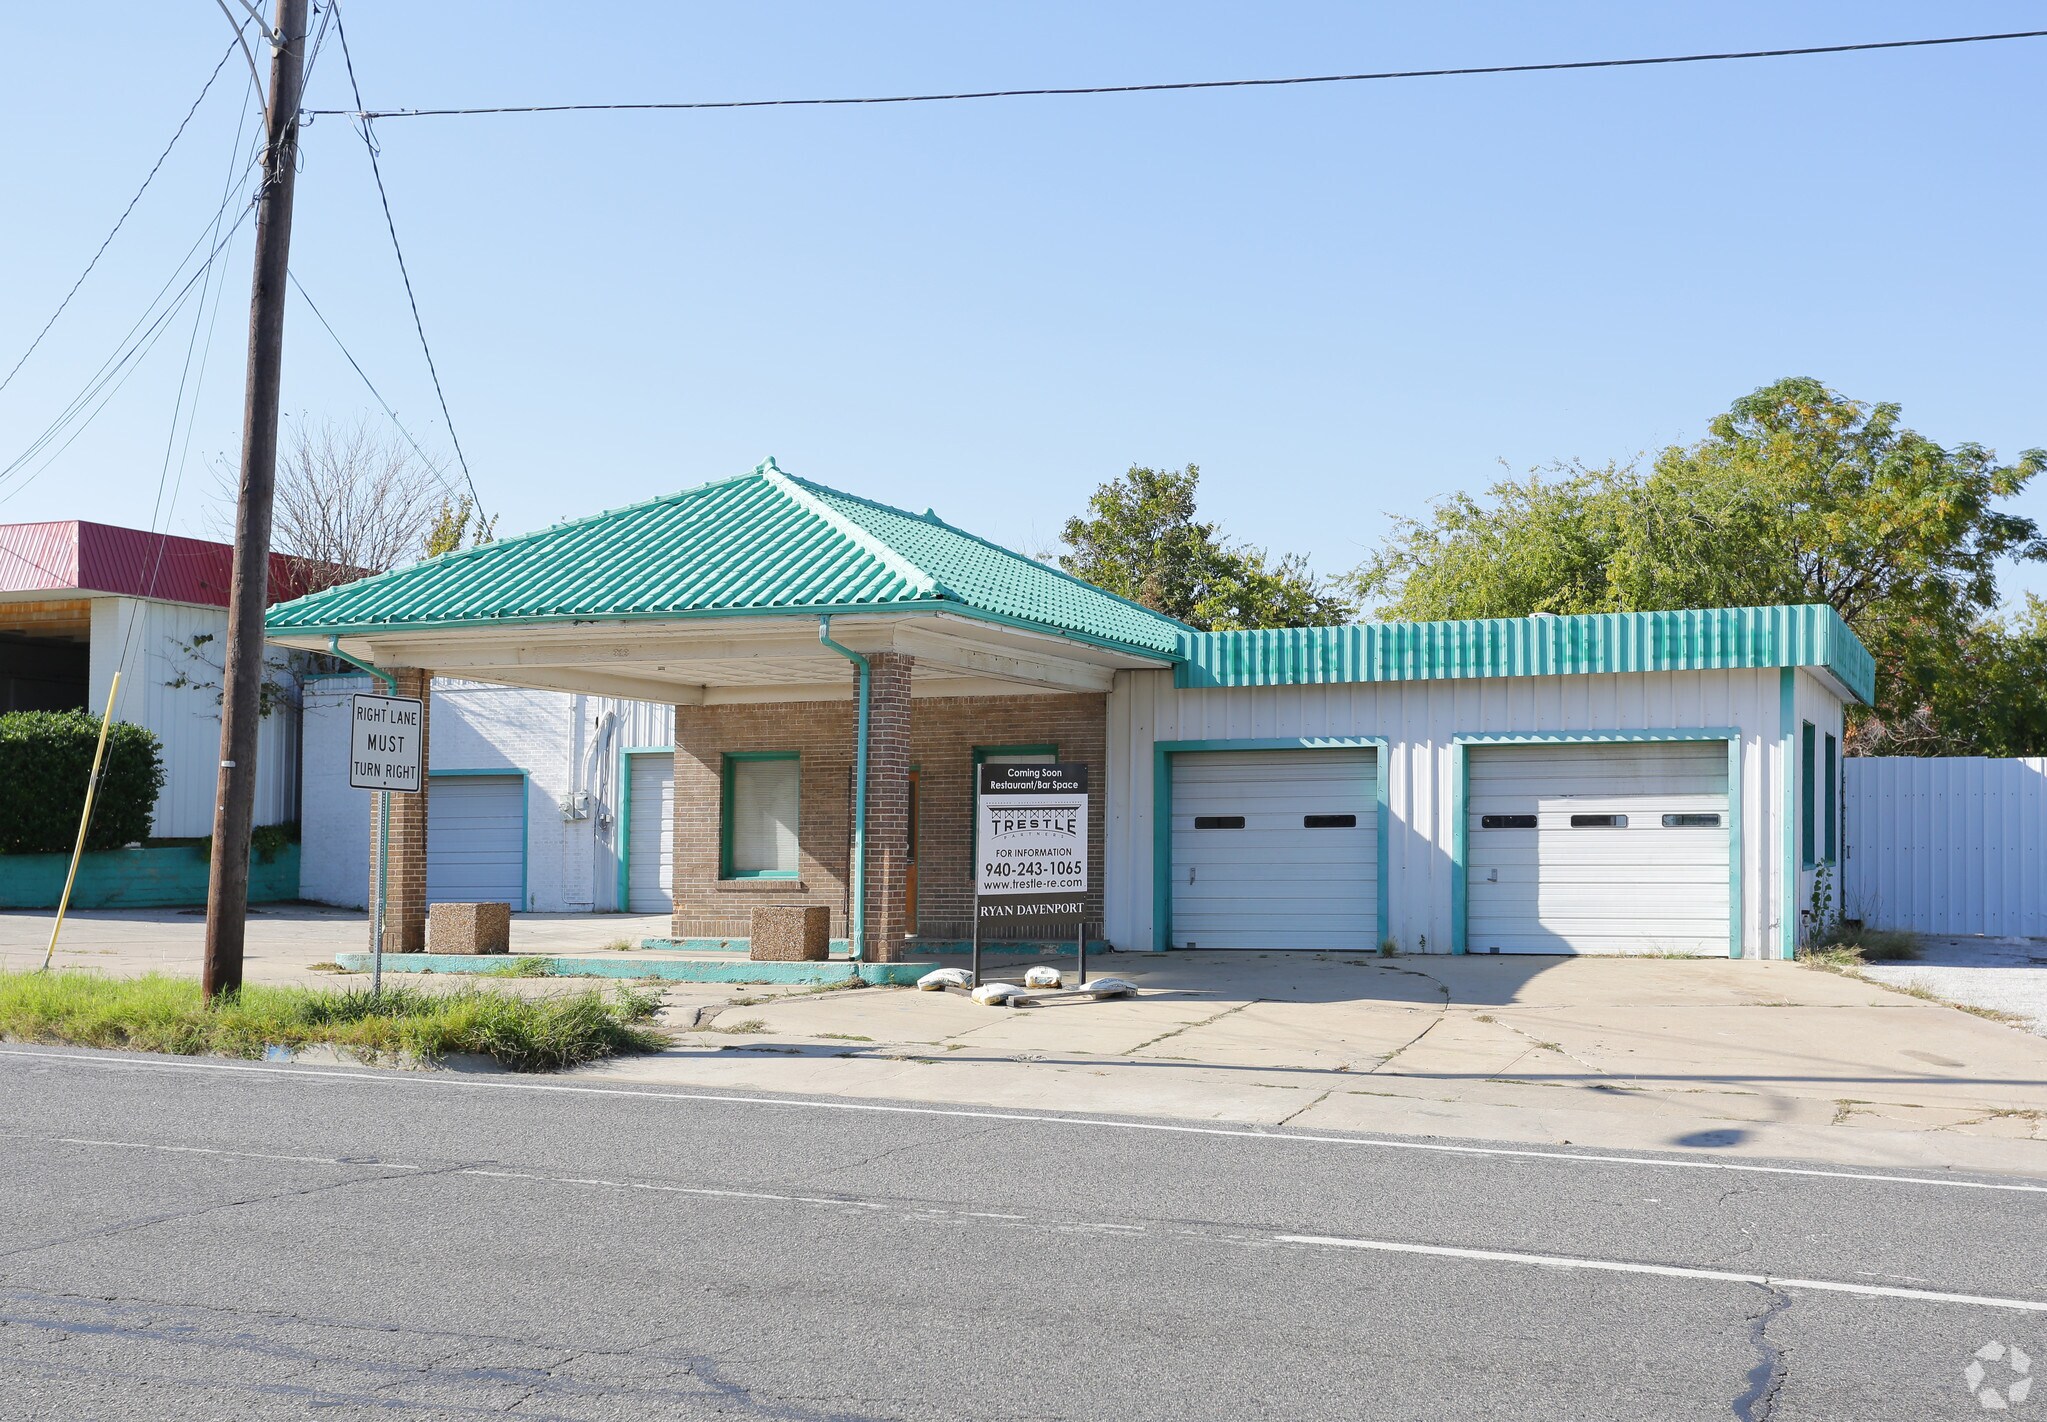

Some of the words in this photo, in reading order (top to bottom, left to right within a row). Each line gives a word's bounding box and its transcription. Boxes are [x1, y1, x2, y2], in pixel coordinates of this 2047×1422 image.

[357, 707, 386, 722] RIGHT
[390, 710, 417, 726] LANE
[368, 733, 404, 753] MUST
[354, 761, 381, 777] TURN
[385, 764, 416, 779] RIGHT
[1007, 768, 1040, 779] Coming
[1042, 768, 1062, 777] Soon
[990, 780, 1050, 790] Restaurant/Bar
[1052, 780, 1078, 790] Space
[991, 819, 1076, 835] TRESTLE
[996, 849, 1012, 858] FOR
[1014, 848, 1072, 858] INFORMATION
[985, 861, 1082, 877] 940-243-1065
[984, 879, 1082, 890] www.trestle-re.com
[980, 905, 1013, 917] RYAN
[1017, 902, 1085, 916] DAVENPORT
